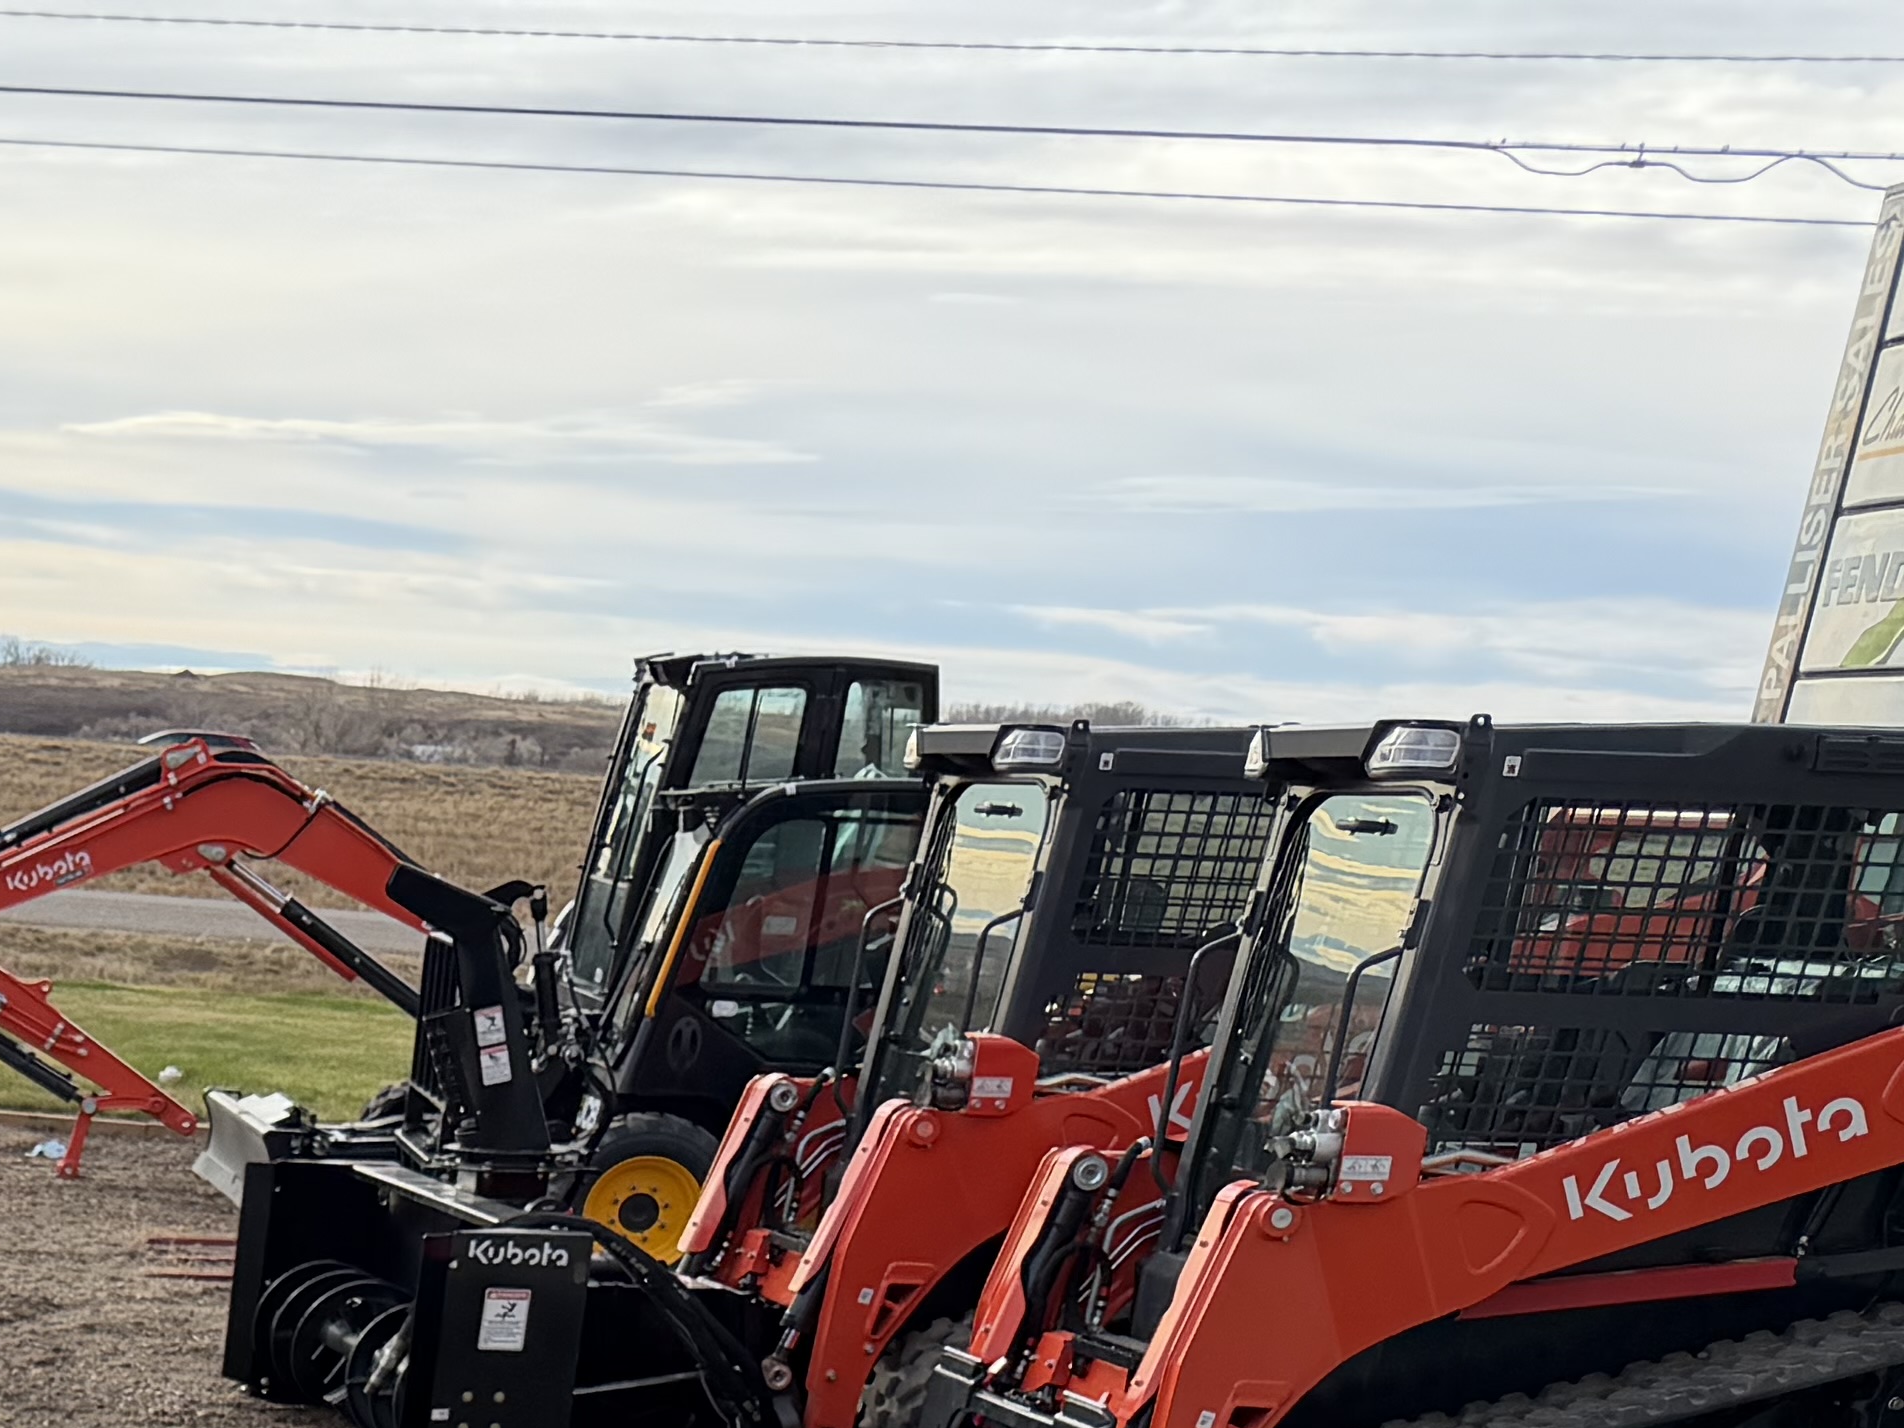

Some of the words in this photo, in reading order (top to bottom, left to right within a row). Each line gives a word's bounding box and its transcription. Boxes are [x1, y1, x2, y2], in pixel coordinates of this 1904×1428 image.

[1760, 435, 1849, 701] PALLISER
[1835, 217, 1902, 415] SALES
[1821, 551, 1904, 608] FEND
[5, 851, 91, 890] Kubota
[1562, 1096, 1869, 1221] Kubota
[468, 1239, 568, 1267] Kubota
